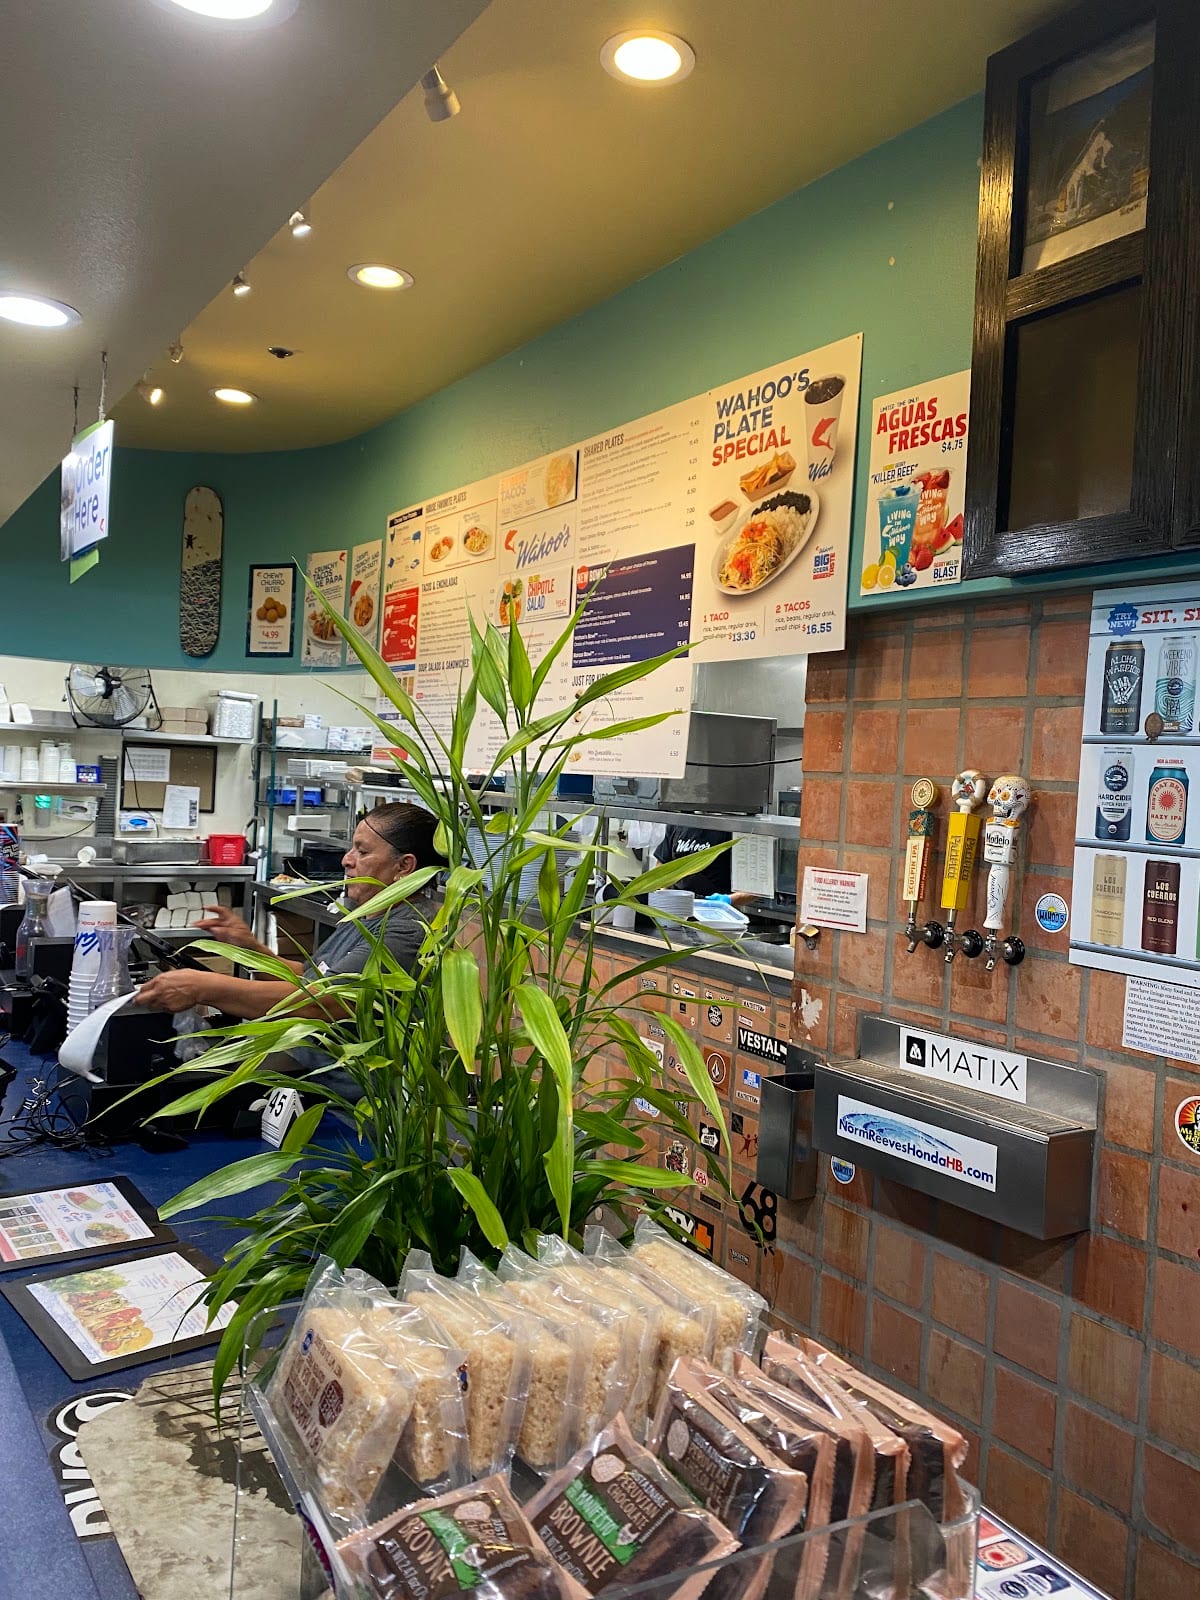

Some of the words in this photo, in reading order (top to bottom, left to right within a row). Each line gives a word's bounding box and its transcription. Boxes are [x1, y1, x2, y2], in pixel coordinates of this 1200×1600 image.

[715, 368, 811, 419] WAHOO'S
[877, 397, 938, 435] AGUAS
[713, 405, 774, 443] PLATE
[888, 413, 967, 455] FRESCAS
[584, 439, 604, 458] SHARED
[604, 433, 624, 450] PLATES
[711, 425, 792, 466] SPECIAL
[941, 438, 963, 453] $4.75
[871, 470, 896, 485] "KILLER
[897, 463, 919, 477] REEF"
[74, 494, 99, 534] Here
[887, 508, 912, 524] LIVING
[515, 522, 570, 570] Wahoo's
[313, 561, 338, 574] CRUNCHY
[814, 553, 830, 568] BIG
[313, 569, 333, 580] TACOS
[933, 565, 959, 579] BLAST
[314, 580, 323, 588] DE
[323, 574, 343, 586] PAPA
[527, 578, 555, 598] CHIPOTLE
[526, 597, 545, 612] SALAD
[775, 605, 781, 614] 2
[784, 600, 811, 612] TACOS
[703, 615, 707, 623] 1
[709, 611, 729, 622] TACO
[786, 615, 802, 623] beans,
[802, 612, 821, 621] regular
[1110, 619, 1136, 628] NEW!
[1114, 612, 1132, 620] TRY
[1141, 609, 1177, 625] SIT,
[262, 630, 279, 639] $4.99
[728, 630, 756, 642] $13.30
[801, 622, 832, 635] $16.55
[1110, 655, 1137, 667] ALOHA
[1163, 649, 1192, 660] WEEKEND
[1106, 664, 1141, 678] WARRIOR
[1167, 660, 1189, 677] VIBES
[572, 674, 584, 687] JUST
[585, 673, 595, 685] FOR
[1097, 793, 1115, 801] HARD
[1154, 782, 1168, 793] DAY
[1169, 782, 1185, 812] BREWING
[986, 832, 1010, 846] Modelo
[908, 861, 917, 895] SCULPIN
[1104, 876, 1116, 884] LOS
[1095, 884, 1123, 894] CUERNOS
[1155, 881, 1170, 891] LOS
[1147, 889, 1177, 901] CUERNOS
[1130, 979, 1160, 989] WARNING:
[739, 1028, 781, 1057] VESTAL
[931, 1043, 1019, 1091] MATIX
[268, 1091, 288, 1117] 45
[839, 1118, 994, 1184] NormReevesHondaHB.com
[617, 1474, 661, 1519] PERUVIAN
[575, 1488, 620, 1537] MANIFESTO
[606, 1482, 650, 1530] CHOCOLATE
[549, 1500, 616, 1578] BROWNIE
[396, 1558, 418, 1581] 2.47
